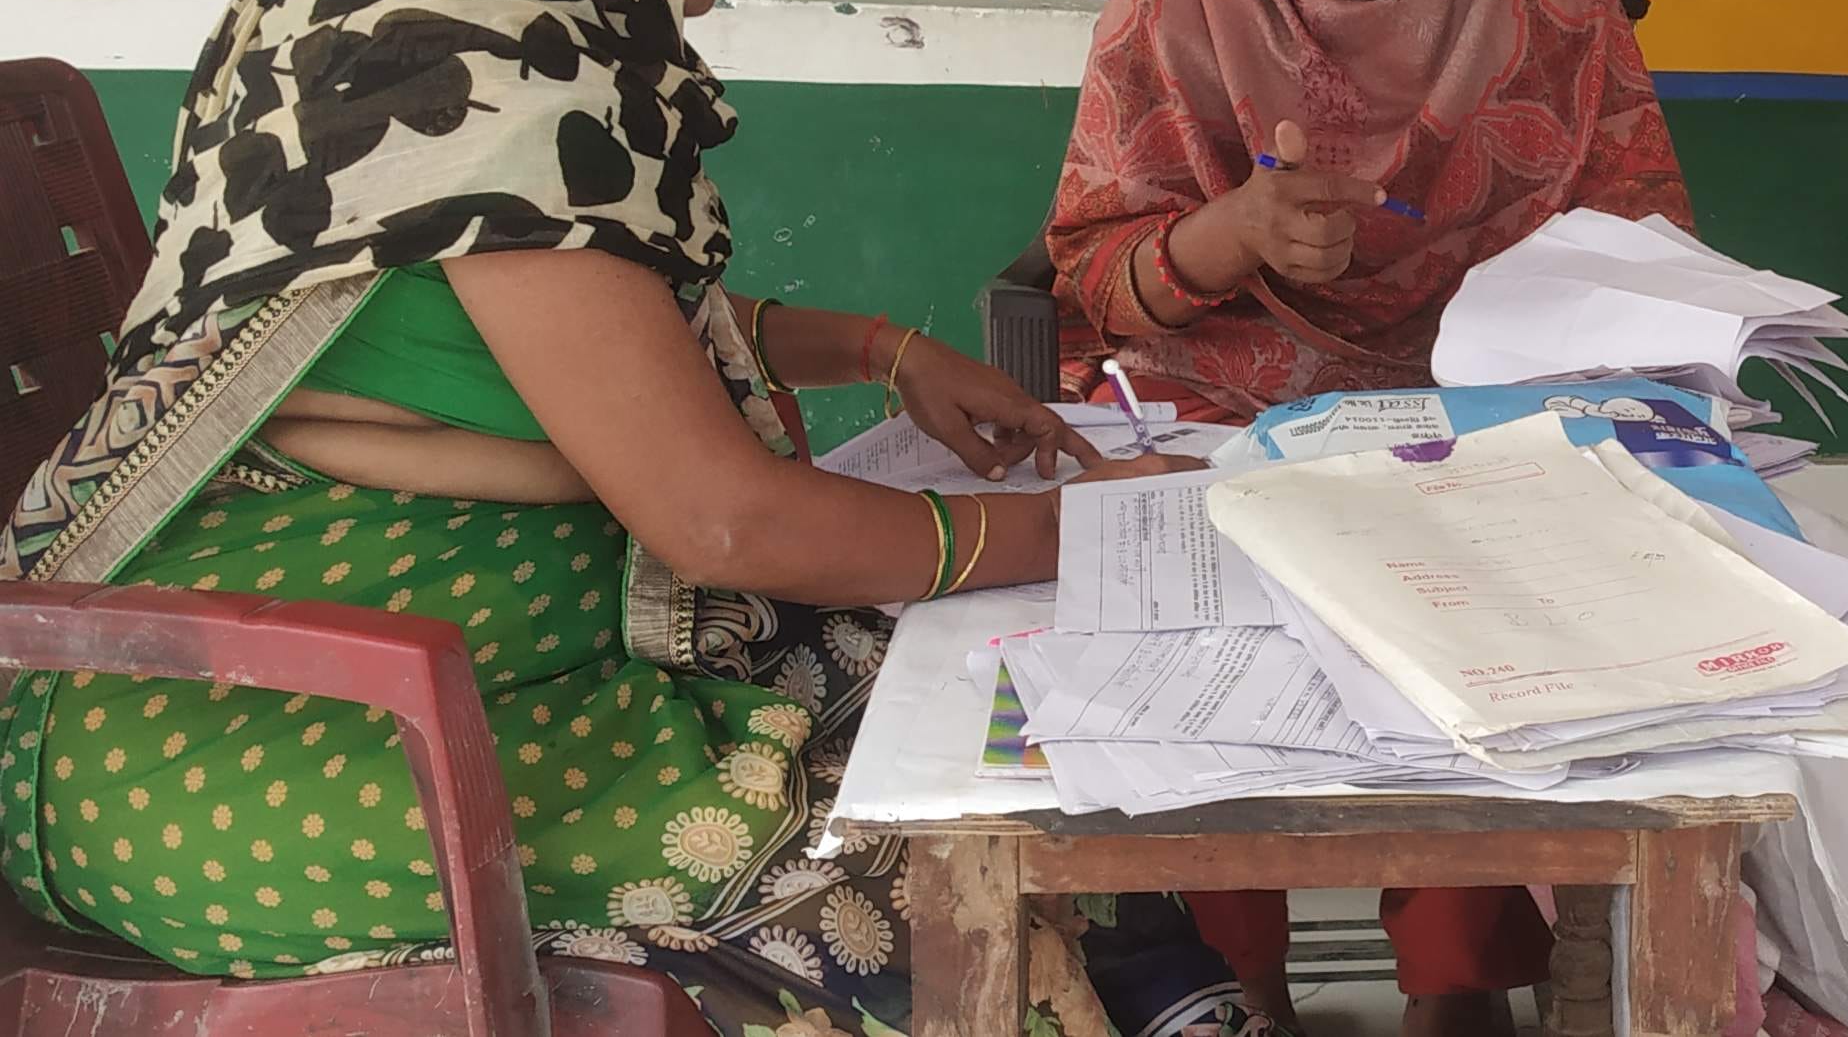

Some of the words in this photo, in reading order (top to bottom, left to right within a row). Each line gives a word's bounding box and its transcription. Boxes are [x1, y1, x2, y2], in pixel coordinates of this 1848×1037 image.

[1402, 572, 1461, 583] Address
[1416, 584, 1470, 596] Subject
[1432, 599, 1470, 610] From
[1537, 597, 1556, 606] To
[1488, 685, 1543, 704] Record
[1544, 680, 1576, 695] File
